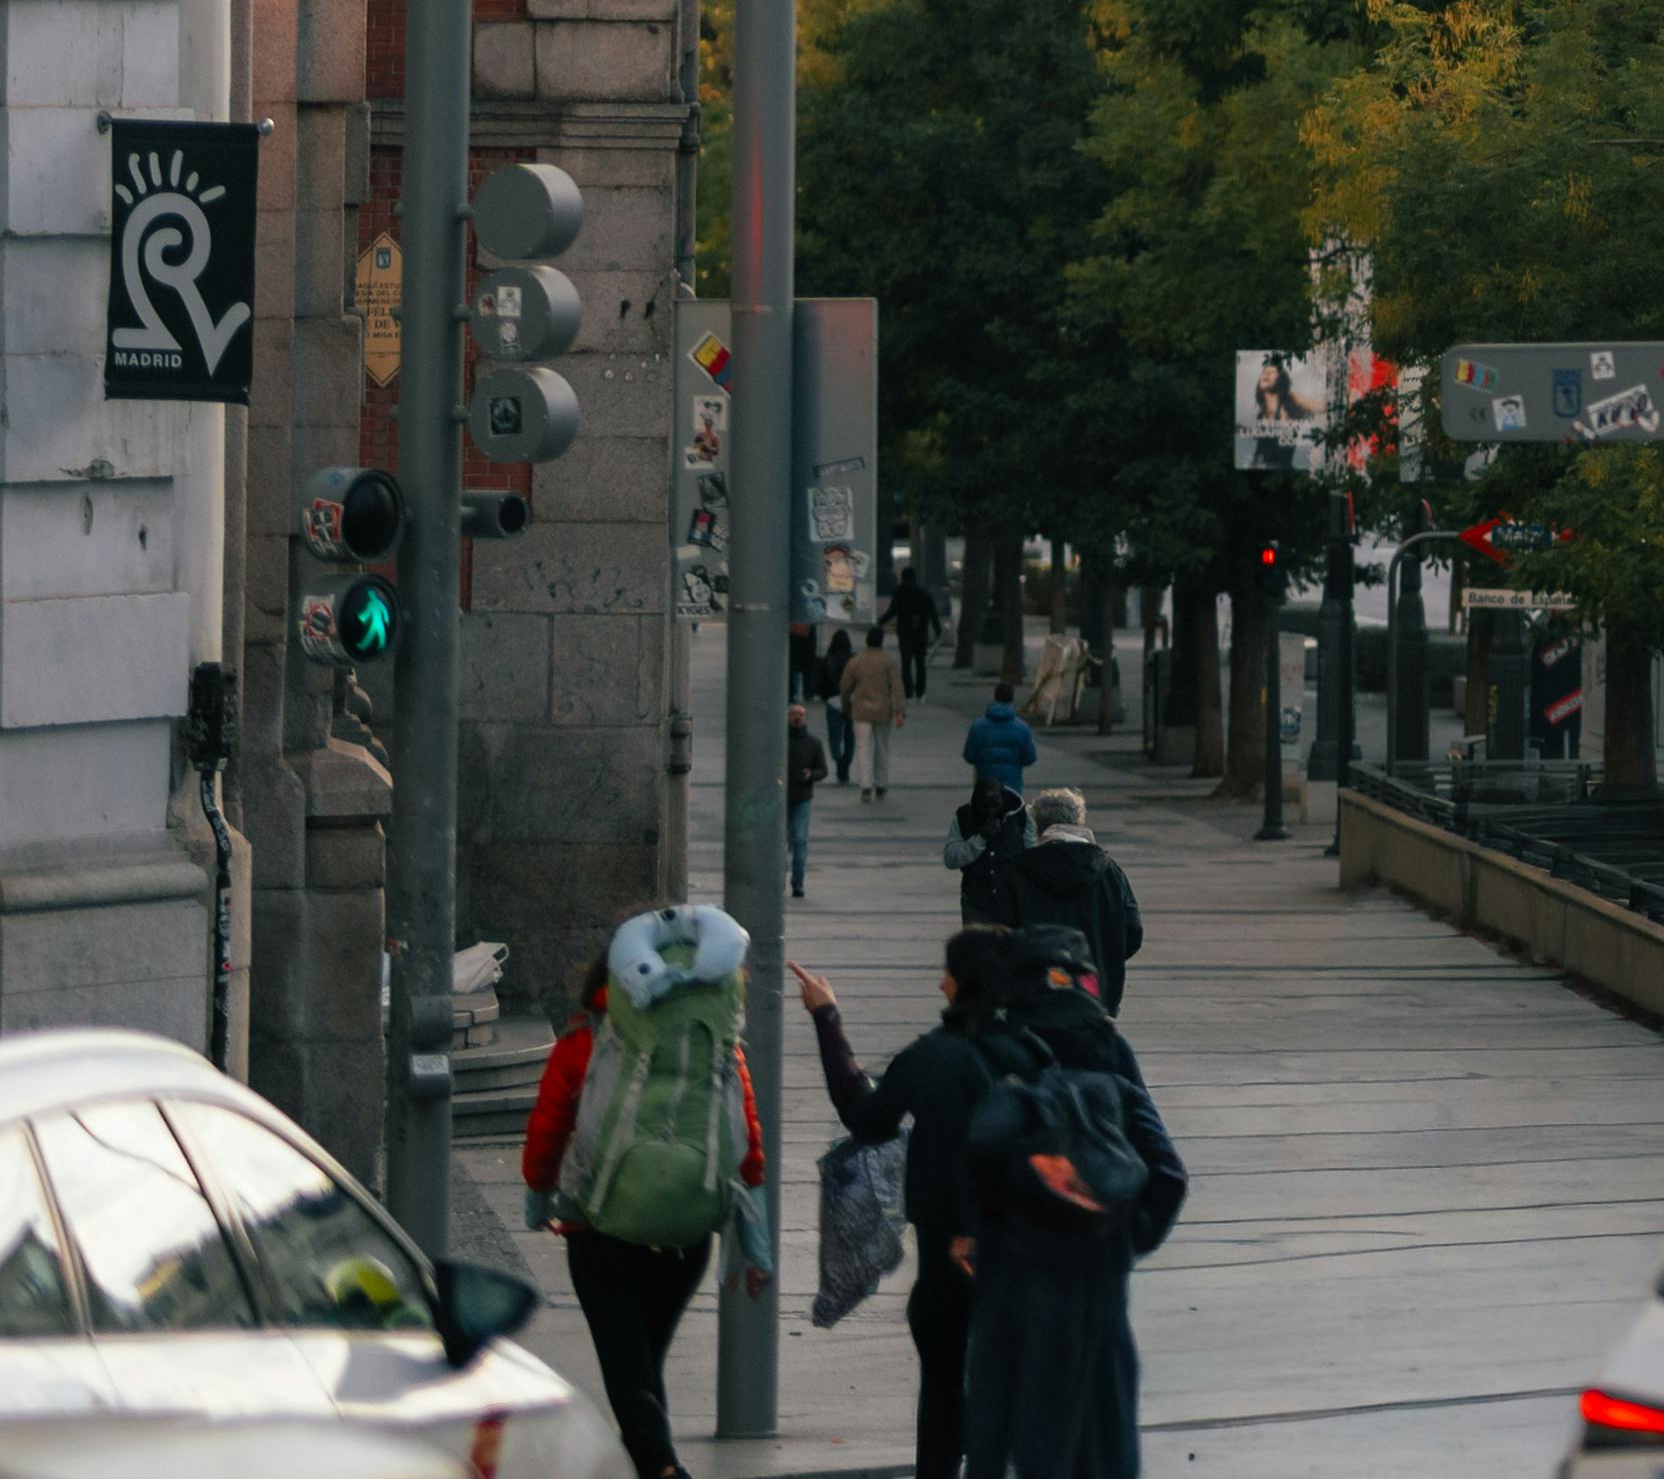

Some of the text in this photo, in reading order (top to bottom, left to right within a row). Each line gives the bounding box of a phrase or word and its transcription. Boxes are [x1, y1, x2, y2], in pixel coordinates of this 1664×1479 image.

[114, 352, 183, 369] MADRID
[1468, 591, 1505, 606] Banco
[1510, 591, 1525, 606] de
